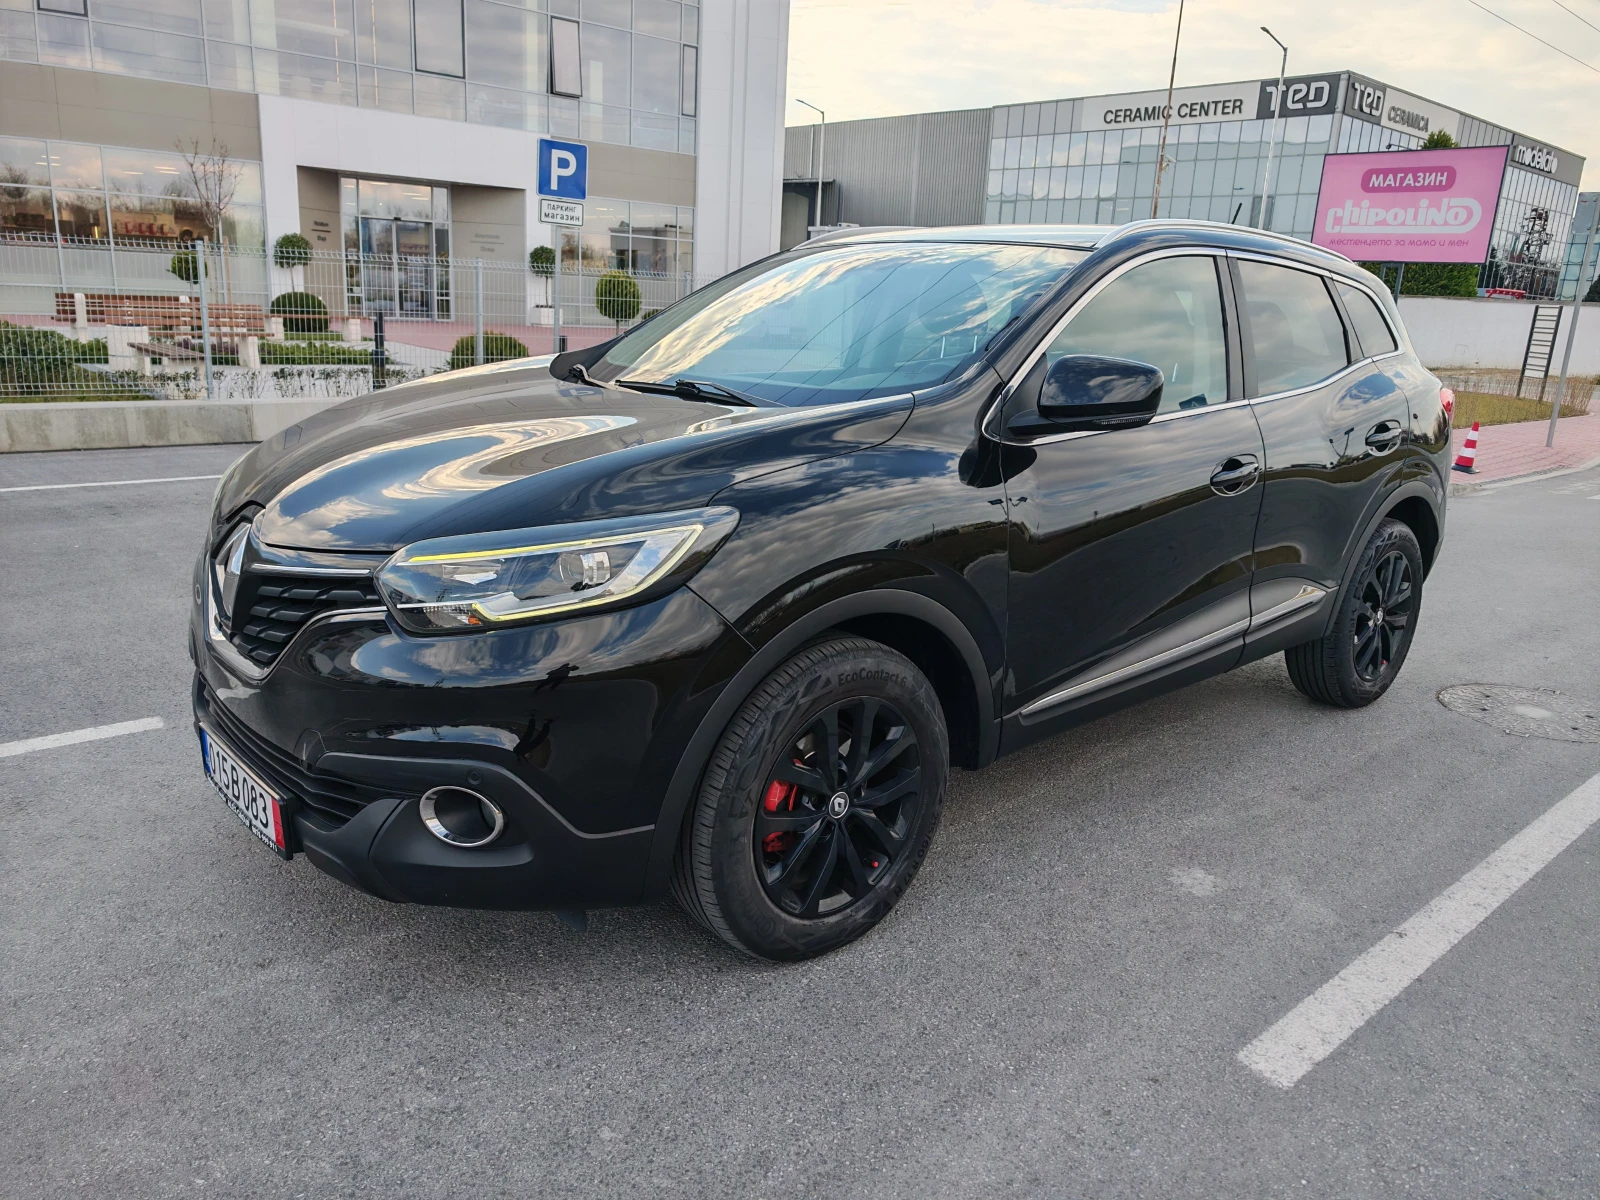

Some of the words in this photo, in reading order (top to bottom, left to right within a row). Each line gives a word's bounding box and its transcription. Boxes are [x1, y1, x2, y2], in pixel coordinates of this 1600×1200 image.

[1103, 104, 1173, 124] CERAMIC
[1177, 98, 1244, 118] CENTER
[1387, 105, 1430, 133] CERAMICA
[550, 148, 577, 191] P
[1368, 171, 1448, 188] МАГАЗИН
[547, 203, 577, 213] ПАРКИНГ
[1329, 237, 1393, 248] местенцето
[1394, 239, 1405, 247] за
[1407, 239, 1437, 248] мама
[1447, 239, 1469, 248] мен
[837, 667, 900, 686] EcoContact
[900, 675, 908, 688] 6
